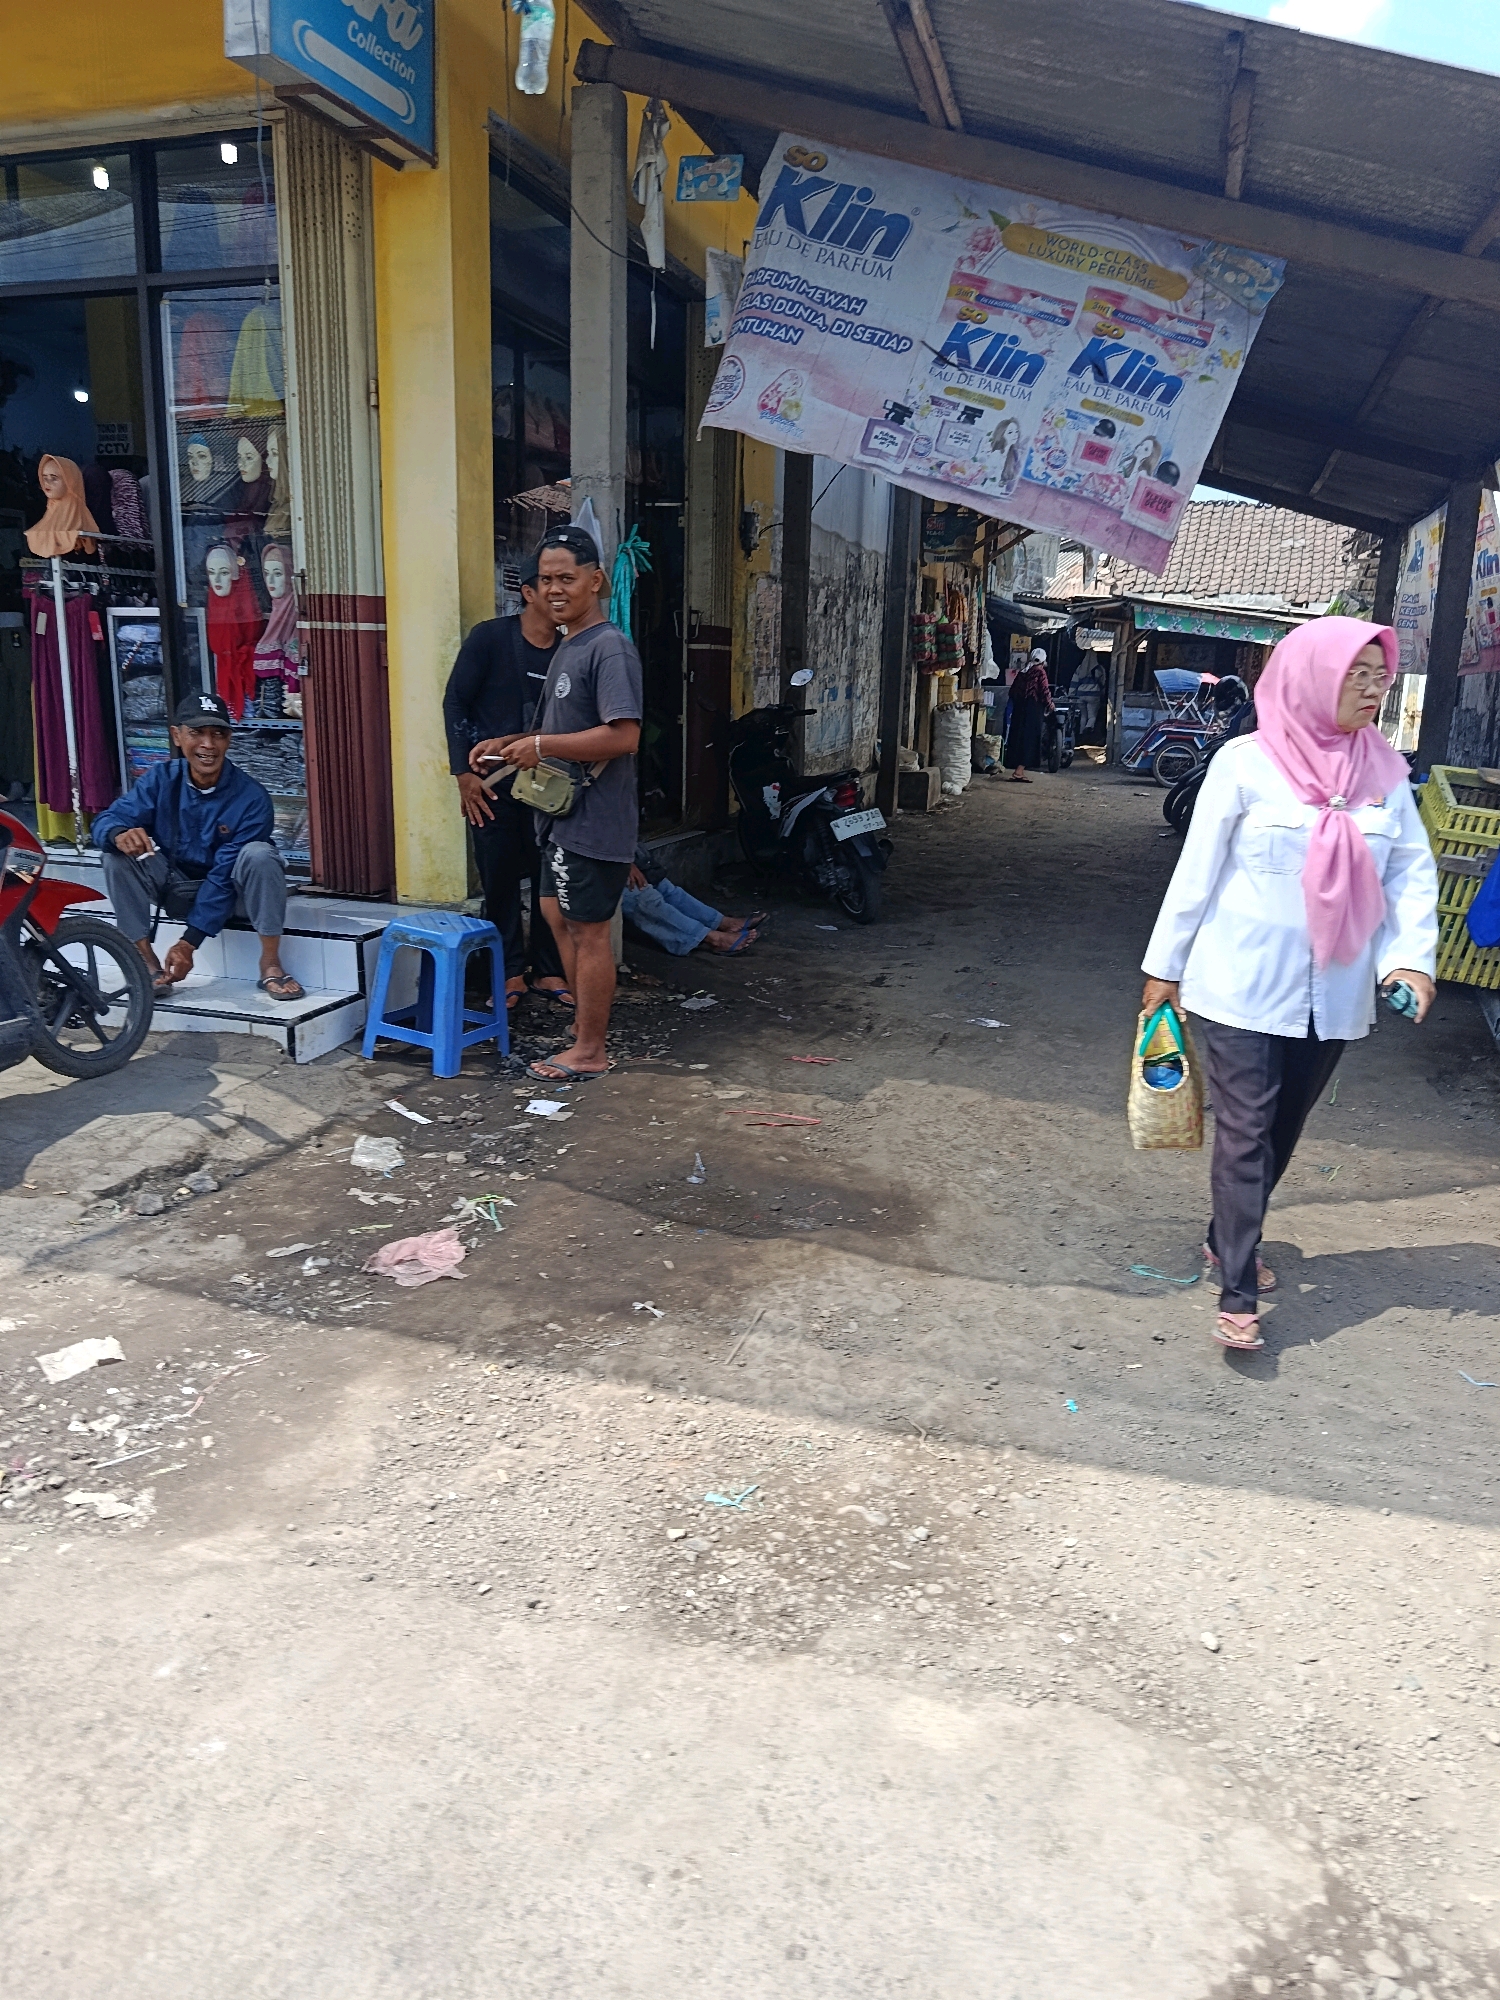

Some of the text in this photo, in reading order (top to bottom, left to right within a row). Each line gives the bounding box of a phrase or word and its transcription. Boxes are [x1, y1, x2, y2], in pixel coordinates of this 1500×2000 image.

[347, 20, 416, 85] Collection
[783, 145, 829, 172] SO
[755, 164, 914, 262] Klin
[754, 229, 894, 281] EAU DE PARFUM
[1028, 242, 1158, 290] LUXURY PERFUME
[1045, 233, 1148, 275] WORLD-CLASS
[799, 281, 867, 316] MEWAH
[957, 305, 990, 324] SO
[772, 296, 828, 332] DUNIA,
[830, 319, 853, 338] DI
[852, 324, 914, 354] SETIAP
[1091, 321, 1126, 340] SO
[932, 322, 1048, 388] Klin
[1067, 336, 1186, 408] Klin
[929, 366, 953, 382] EAU
[957, 373, 974, 387] DE
[977, 379, 1033, 402] PARFUM
[1063, 377, 1091, 394] EAU
[1093, 386, 1112, 401] DE
[1115, 393, 1172, 421] PARFUM
[96, 443, 130, 455] CCTV
